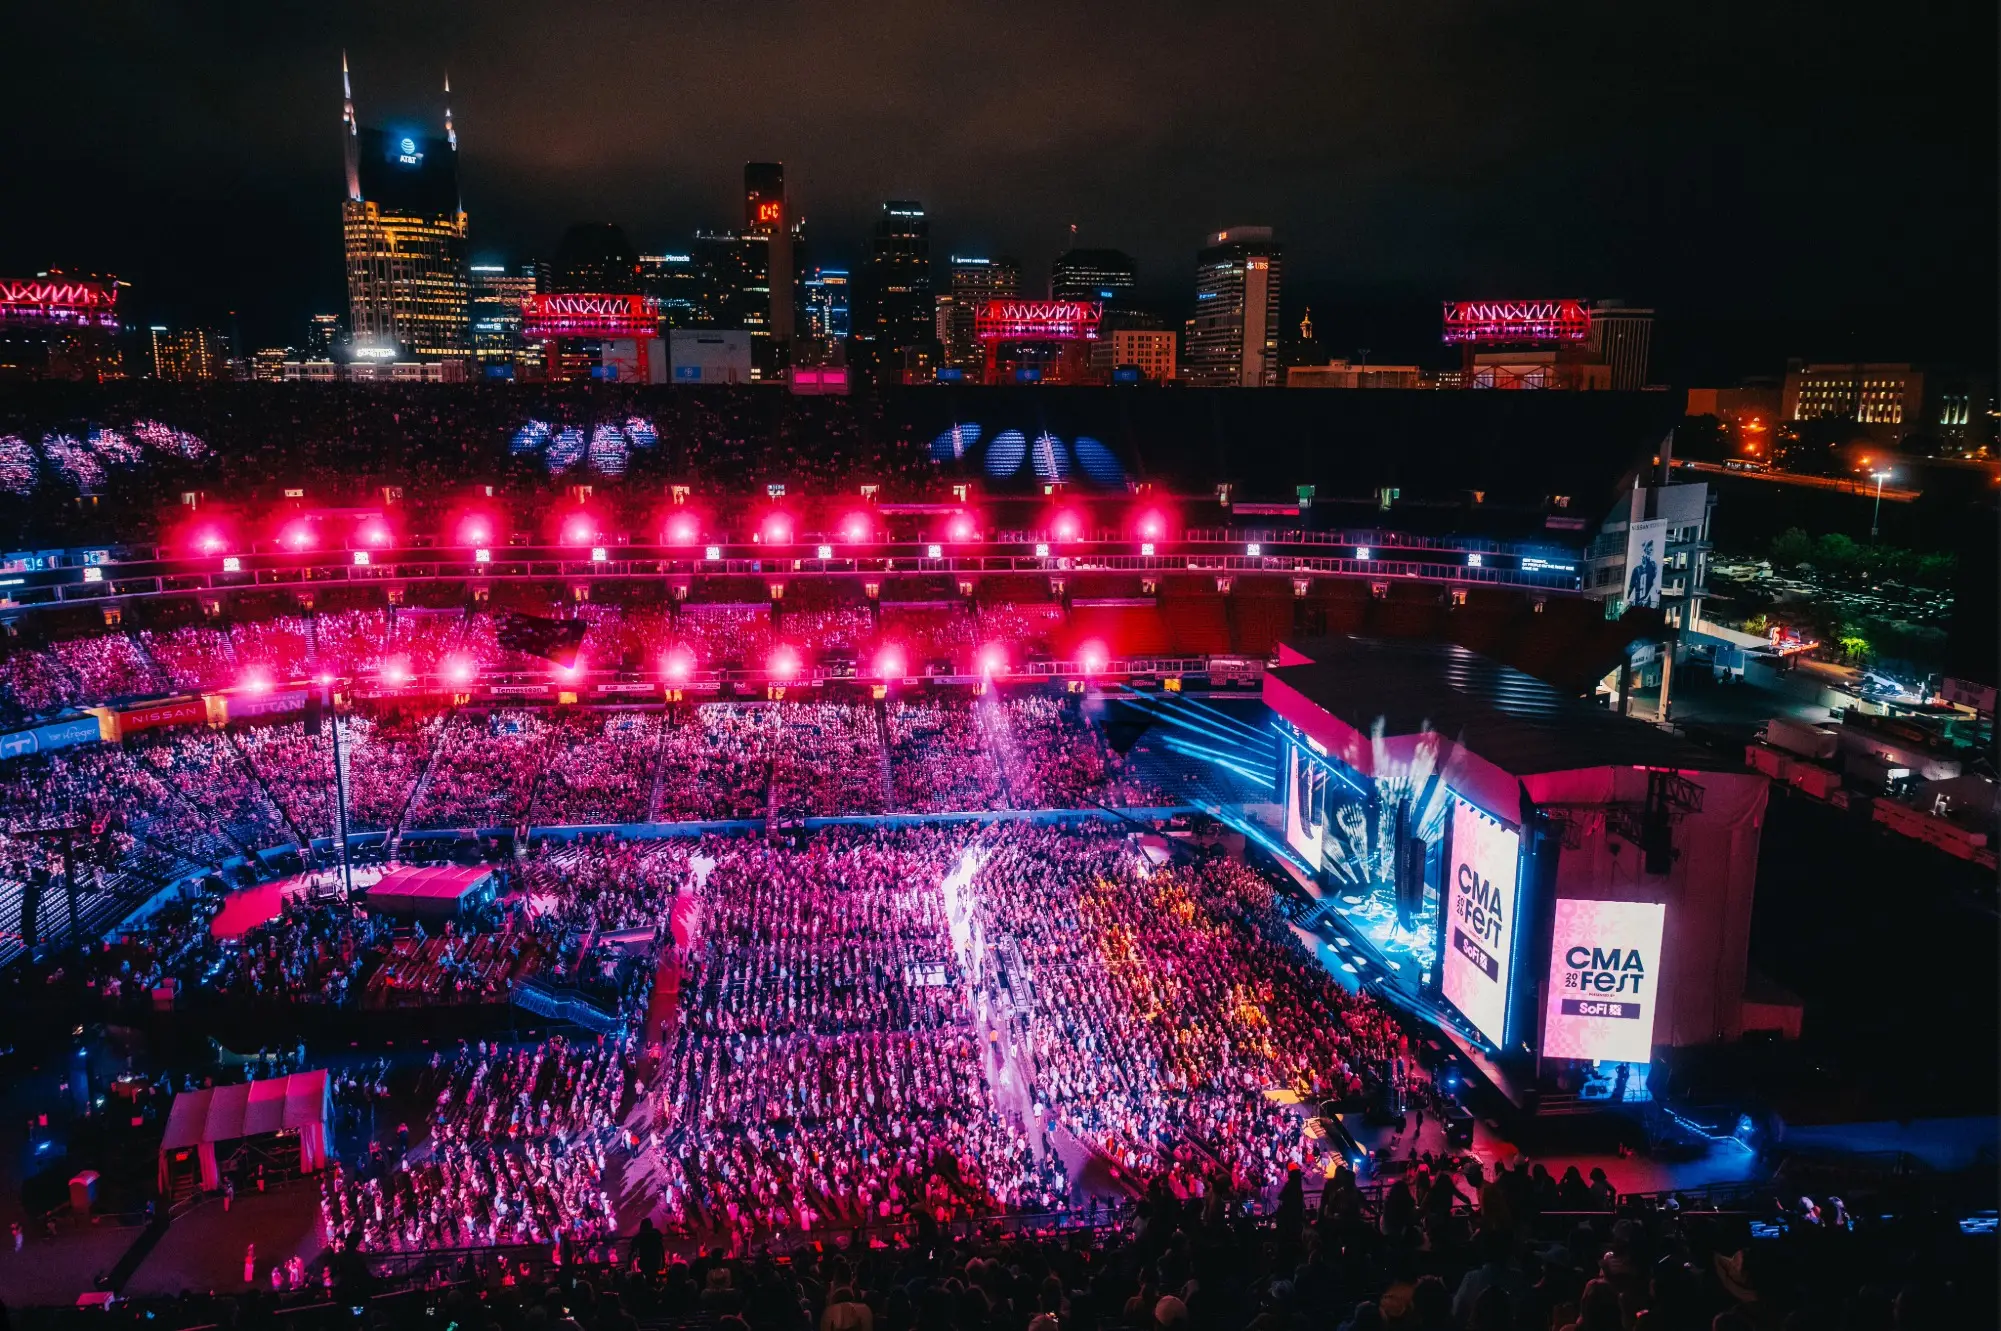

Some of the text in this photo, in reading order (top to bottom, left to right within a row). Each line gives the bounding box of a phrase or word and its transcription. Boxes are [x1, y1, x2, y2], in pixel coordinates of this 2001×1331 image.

[400, 155, 416, 164] AT&T
[1255, 262, 1268, 270] UBS
[132, 708, 197, 724] NISSAN
[63, 726, 96, 741] Kroger
[1458, 863, 1502, 922] CMA
[1462, 938, 1480, 963] SoFi
[1565, 946, 1645, 972] CMA
[1566, 972, 1578, 980] 20
[1579, 1002, 1608, 1015] SoFi
